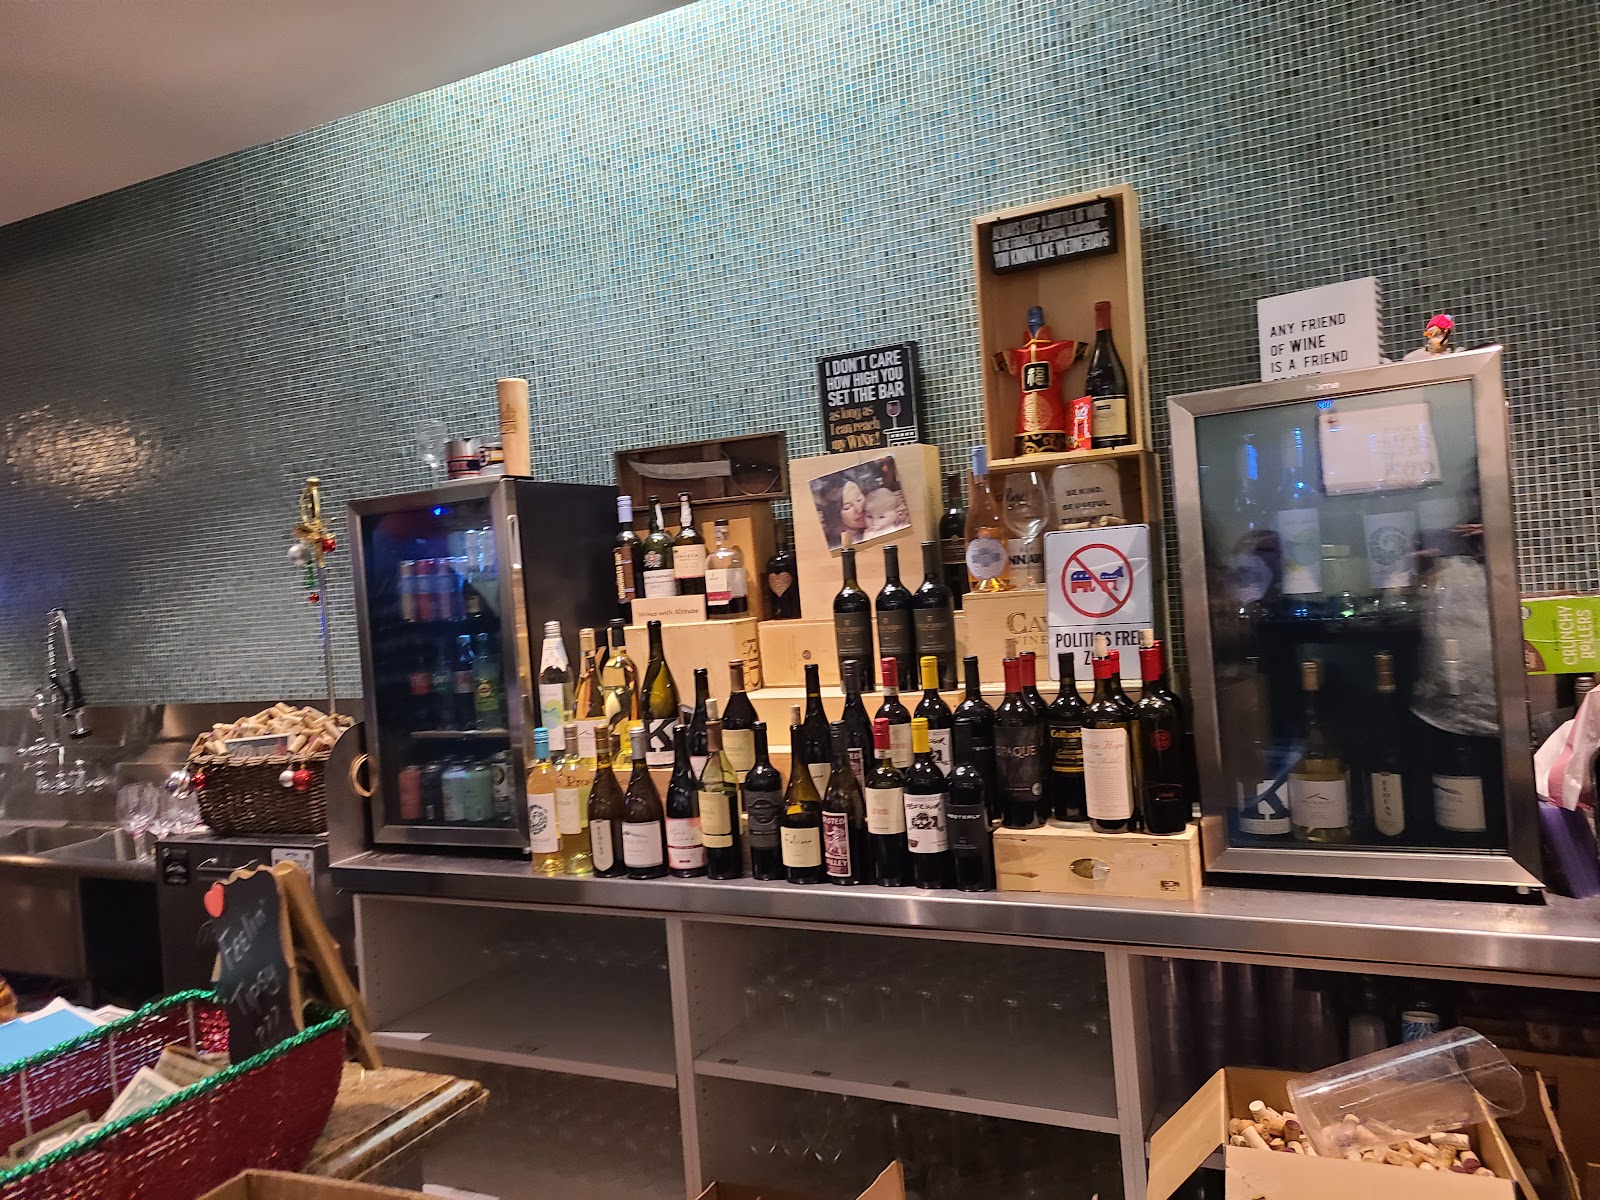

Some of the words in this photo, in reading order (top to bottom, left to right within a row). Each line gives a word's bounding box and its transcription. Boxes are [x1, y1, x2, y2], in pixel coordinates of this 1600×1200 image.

[994, 252, 1010, 268] YOU
[1010, 246, 1036, 265] KNOW
[1037, 242, 1055, 261] LIKE
[1056, 231, 1110, 256] WEDNESDAYS
[1270, 323, 1294, 338] ANY
[1302, 314, 1346, 332] FRIEND
[1270, 344, 1285, 356] OF
[1290, 334, 1326, 352] WINE
[825, 362, 830, 376] I
[832, 356, 867, 376] DON'T
[869, 350, 902, 369] CARE
[1270, 362, 1282, 373] IS
[1289, 359, 1296, 370] A
[1304, 350, 1348, 368] FRIEND
[826, 374, 852, 392] HOW
[852, 370, 880, 387] HIGH
[880, 366, 904, 382] YOU
[828, 390, 850, 406] SET
[852, 386, 876, 403] THE
[878, 382, 905, 400] BAR
[1557, 605, 1578, 666] CRUNCHY
[1576, 609, 1596, 658] ROLLERS
[996, 746, 1036, 758] OPAQUE
